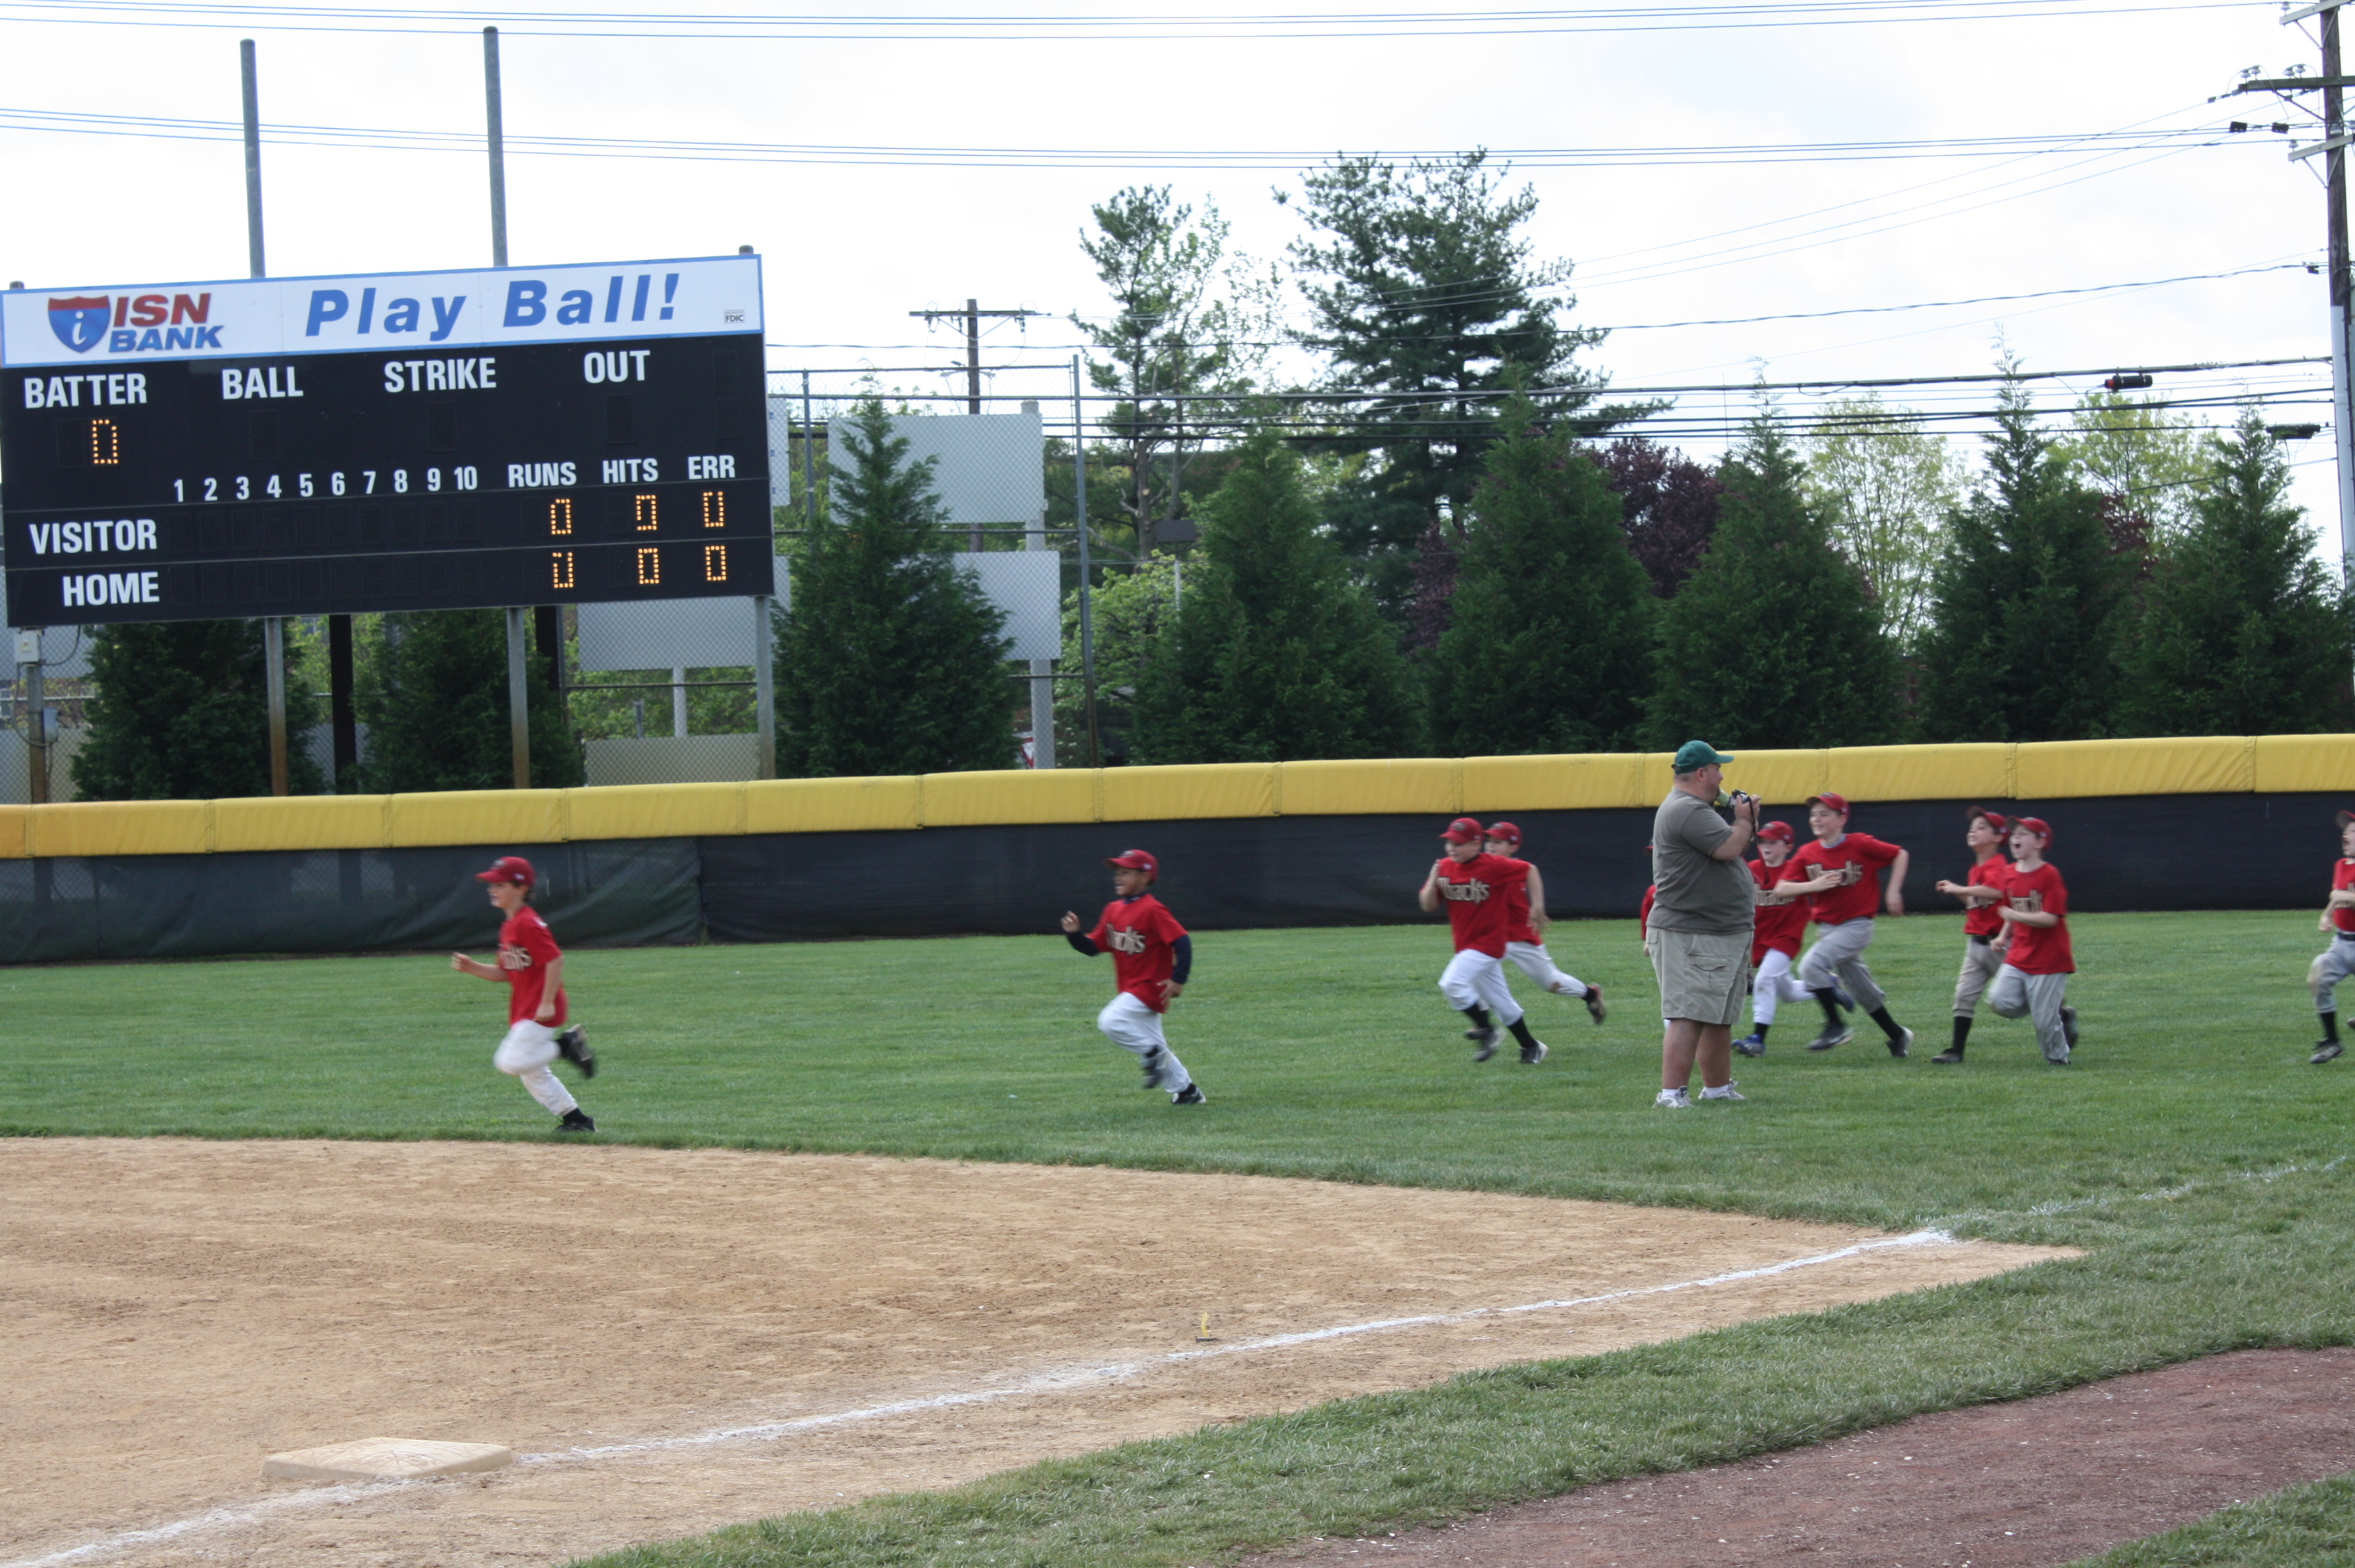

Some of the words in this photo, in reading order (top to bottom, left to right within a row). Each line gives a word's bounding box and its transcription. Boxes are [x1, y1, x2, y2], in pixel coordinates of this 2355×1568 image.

[114, 293, 211, 327] ISN
[305, 287, 467, 342] Play
[503, 272, 680, 328] Ball!
[725, 314, 744, 323] FDIC
[108, 325, 224, 352] BANK
[25, 374, 146, 408] BATTER
[223, 367, 303, 399] BALL
[385, 358, 496, 392] STRIKE
[584, 350, 650, 383] OUT
[175, 480, 183, 502] 1
[205, 478, 217, 500] 2
[236, 477, 249, 500] 3
[268, 475, 281, 497] 4
[300, 474, 313, 496] 5
[333, 473, 345, 495] 6
[364, 471, 375, 493] 7
[394, 470, 407, 493] 8
[428, 468, 440, 491] 9
[455, 467, 477, 490] 10
[509, 462, 576, 487] RUNS
[603, 458, 658, 483] HITS
[689, 455, 735, 479] ERR
[30, 519, 156, 554] VISITOR
[638, 548, 659, 584] 0
[705, 546, 726, 580] 0
[63, 572, 159, 606] HOME
